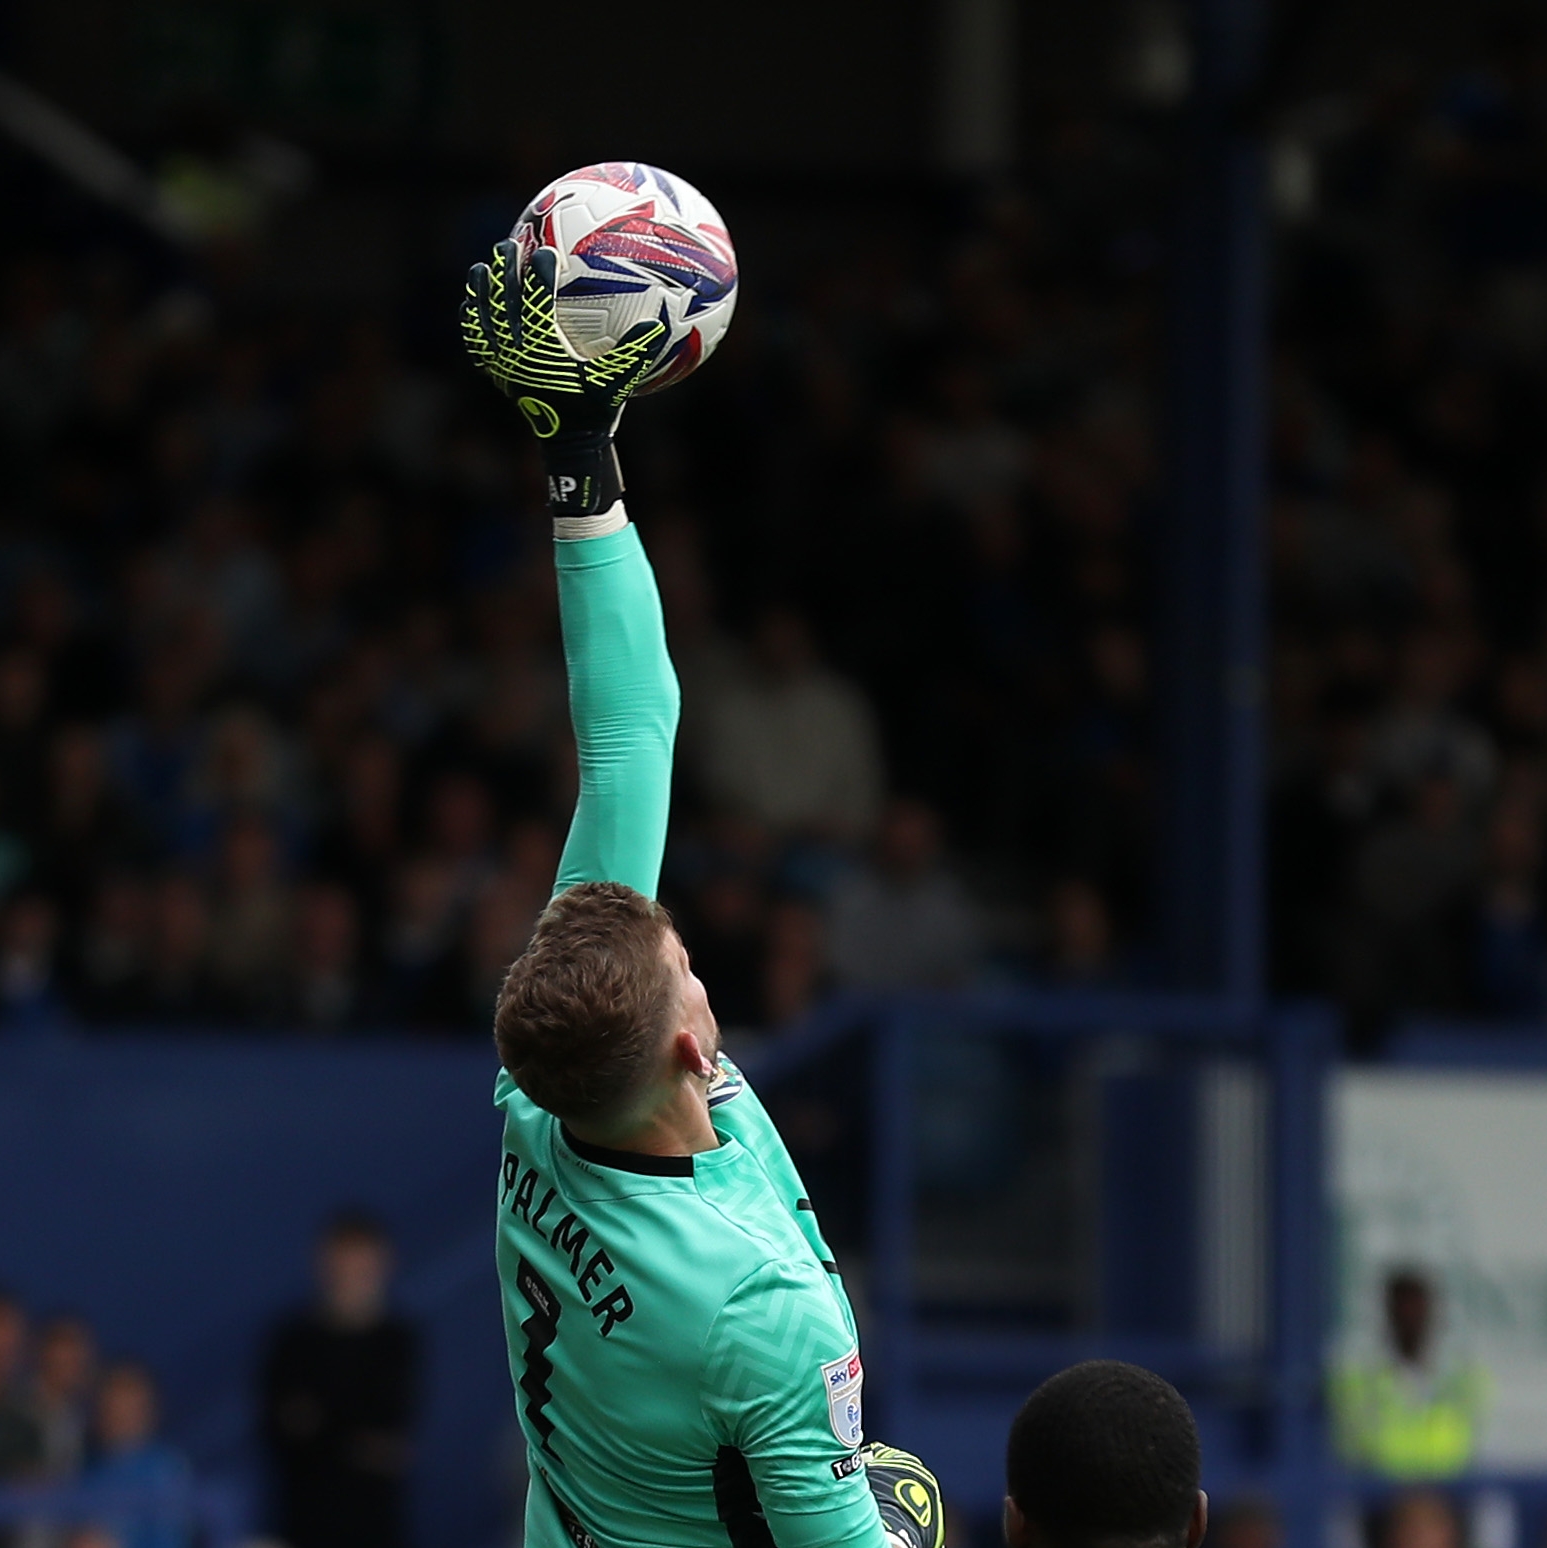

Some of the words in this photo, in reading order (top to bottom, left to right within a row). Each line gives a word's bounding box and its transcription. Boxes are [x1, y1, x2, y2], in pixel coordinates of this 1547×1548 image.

[610, 360, 653, 406] uhlsport
[501, 1151, 634, 1337] PALMER
[830, 1368, 848, 1386] sky
